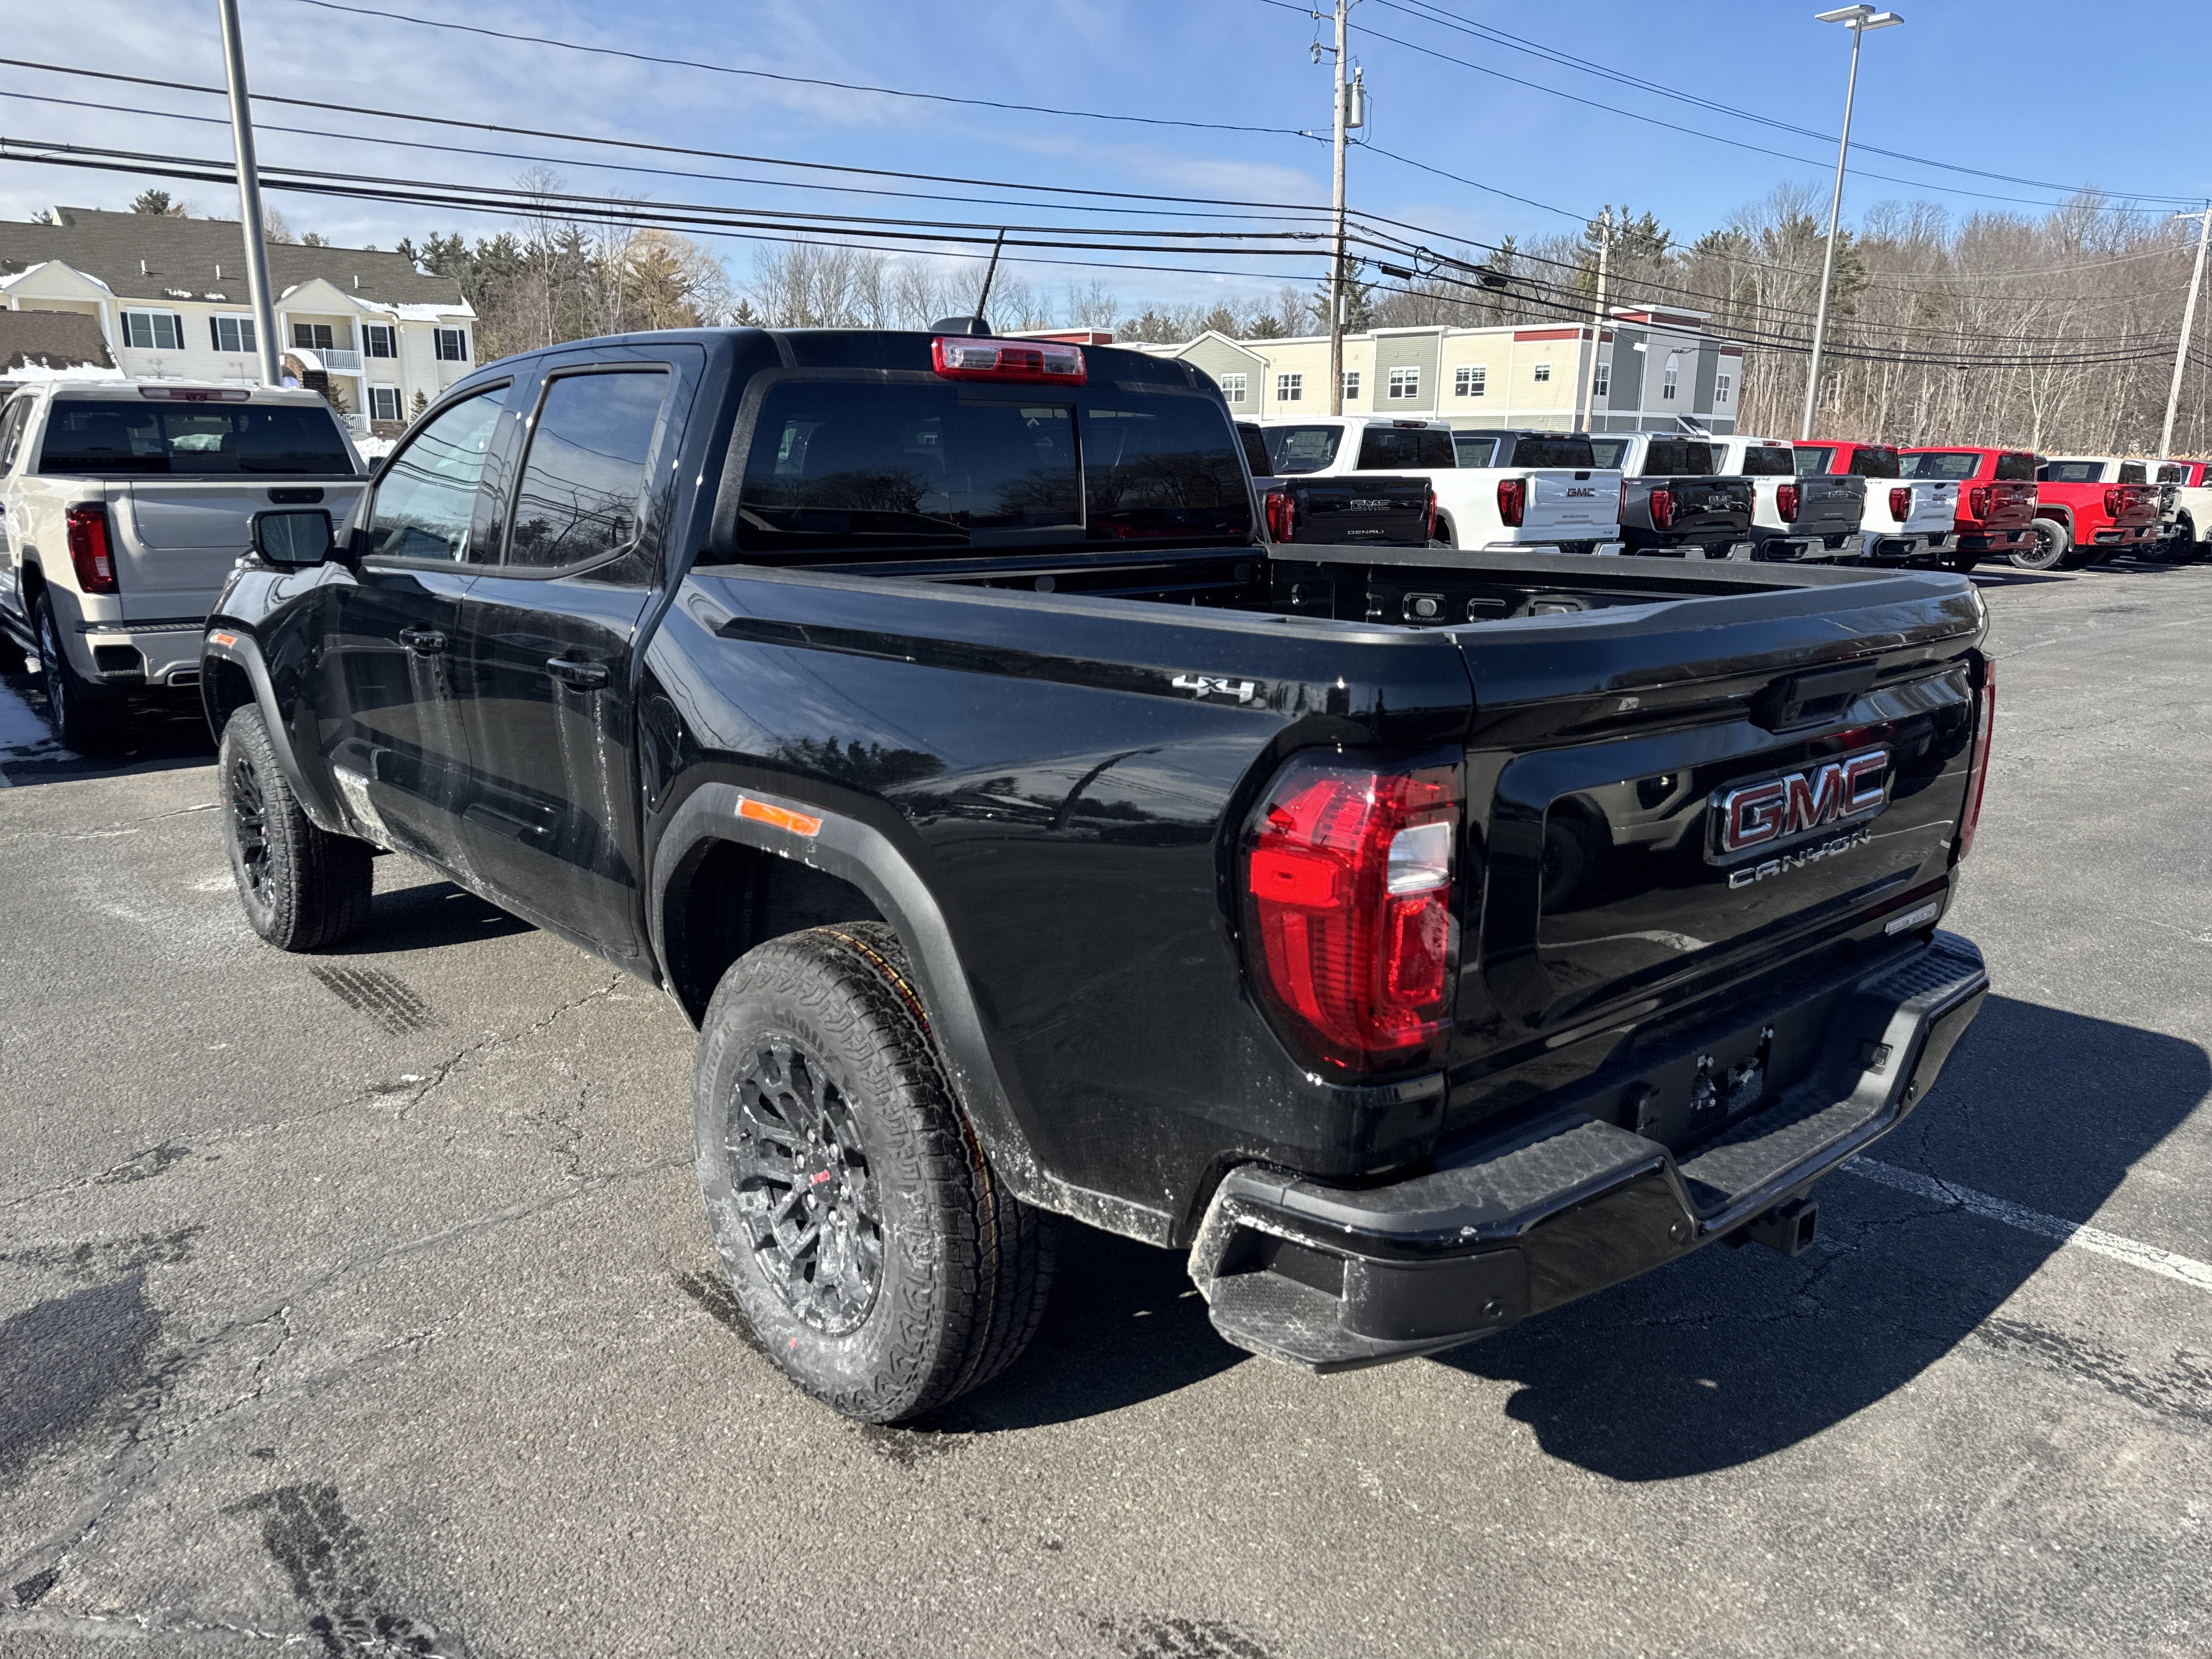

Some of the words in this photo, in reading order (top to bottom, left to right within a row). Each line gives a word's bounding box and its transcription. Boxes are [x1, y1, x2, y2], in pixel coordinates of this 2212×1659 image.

[1566, 488, 1595, 498] GMC
[1350, 499, 1391, 511] GMC
[1708, 495, 1733, 505] GMC
[1723, 749, 1887, 853] GMC
[1728, 830, 1871, 890] CANYON
